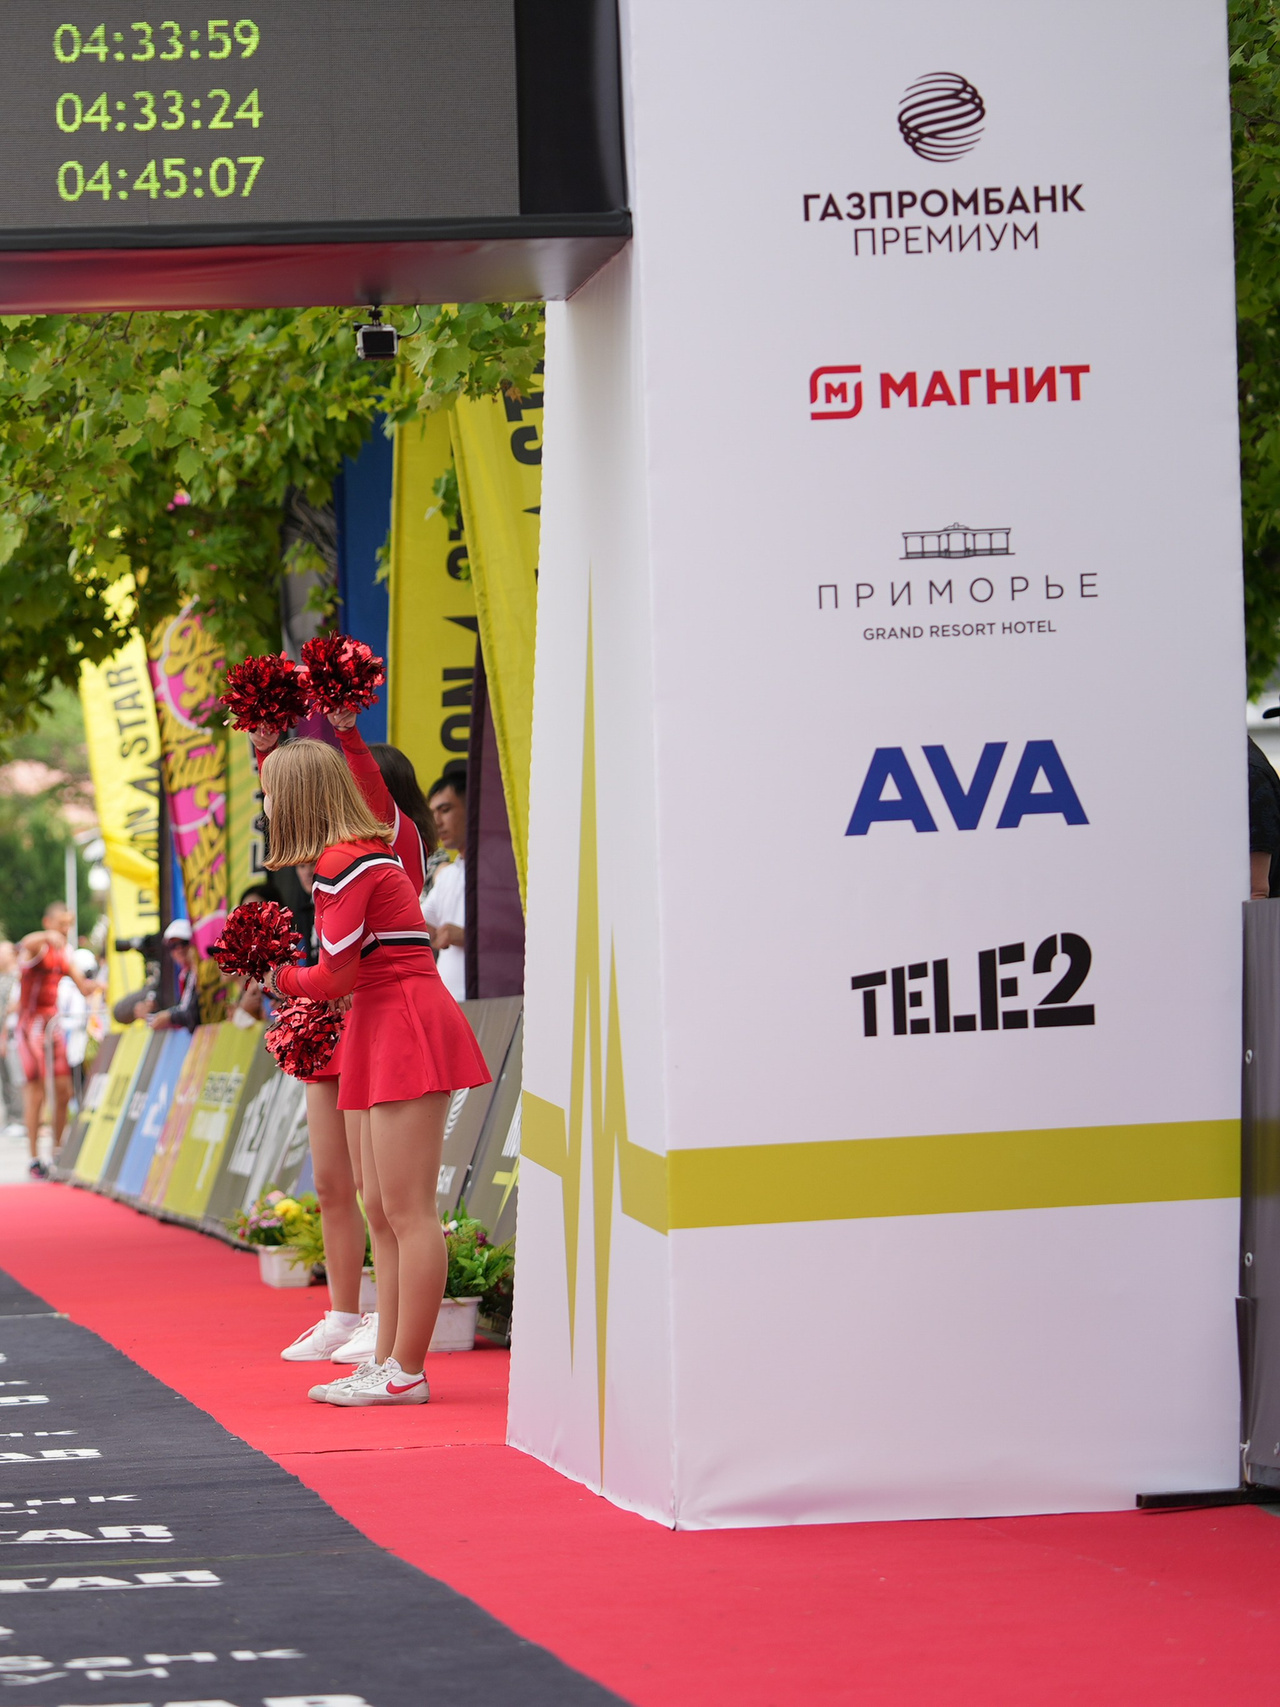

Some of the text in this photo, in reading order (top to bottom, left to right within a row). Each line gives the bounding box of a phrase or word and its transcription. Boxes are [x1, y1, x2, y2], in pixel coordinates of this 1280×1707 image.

[53, 20, 260, 63] 04:33:59
[56, 89, 264, 132] 04:33:24
[57, 156, 264, 201] 04:45:07
[803, 184, 1085, 221] ГАЗПРОМБАНК
[854, 222, 1039, 256] ПРЕМИУМ
[880, 364, 1090, 409] МАГНИТ
[818, 572, 1099, 610] ПРИМОРЬЕ
[863, 620, 1057, 641] GRAND RESORT HOTEL
[106, 664, 150, 759] STAR
[845, 739, 1090, 836] AVA
[851, 932, 1095, 1037] TELE2
